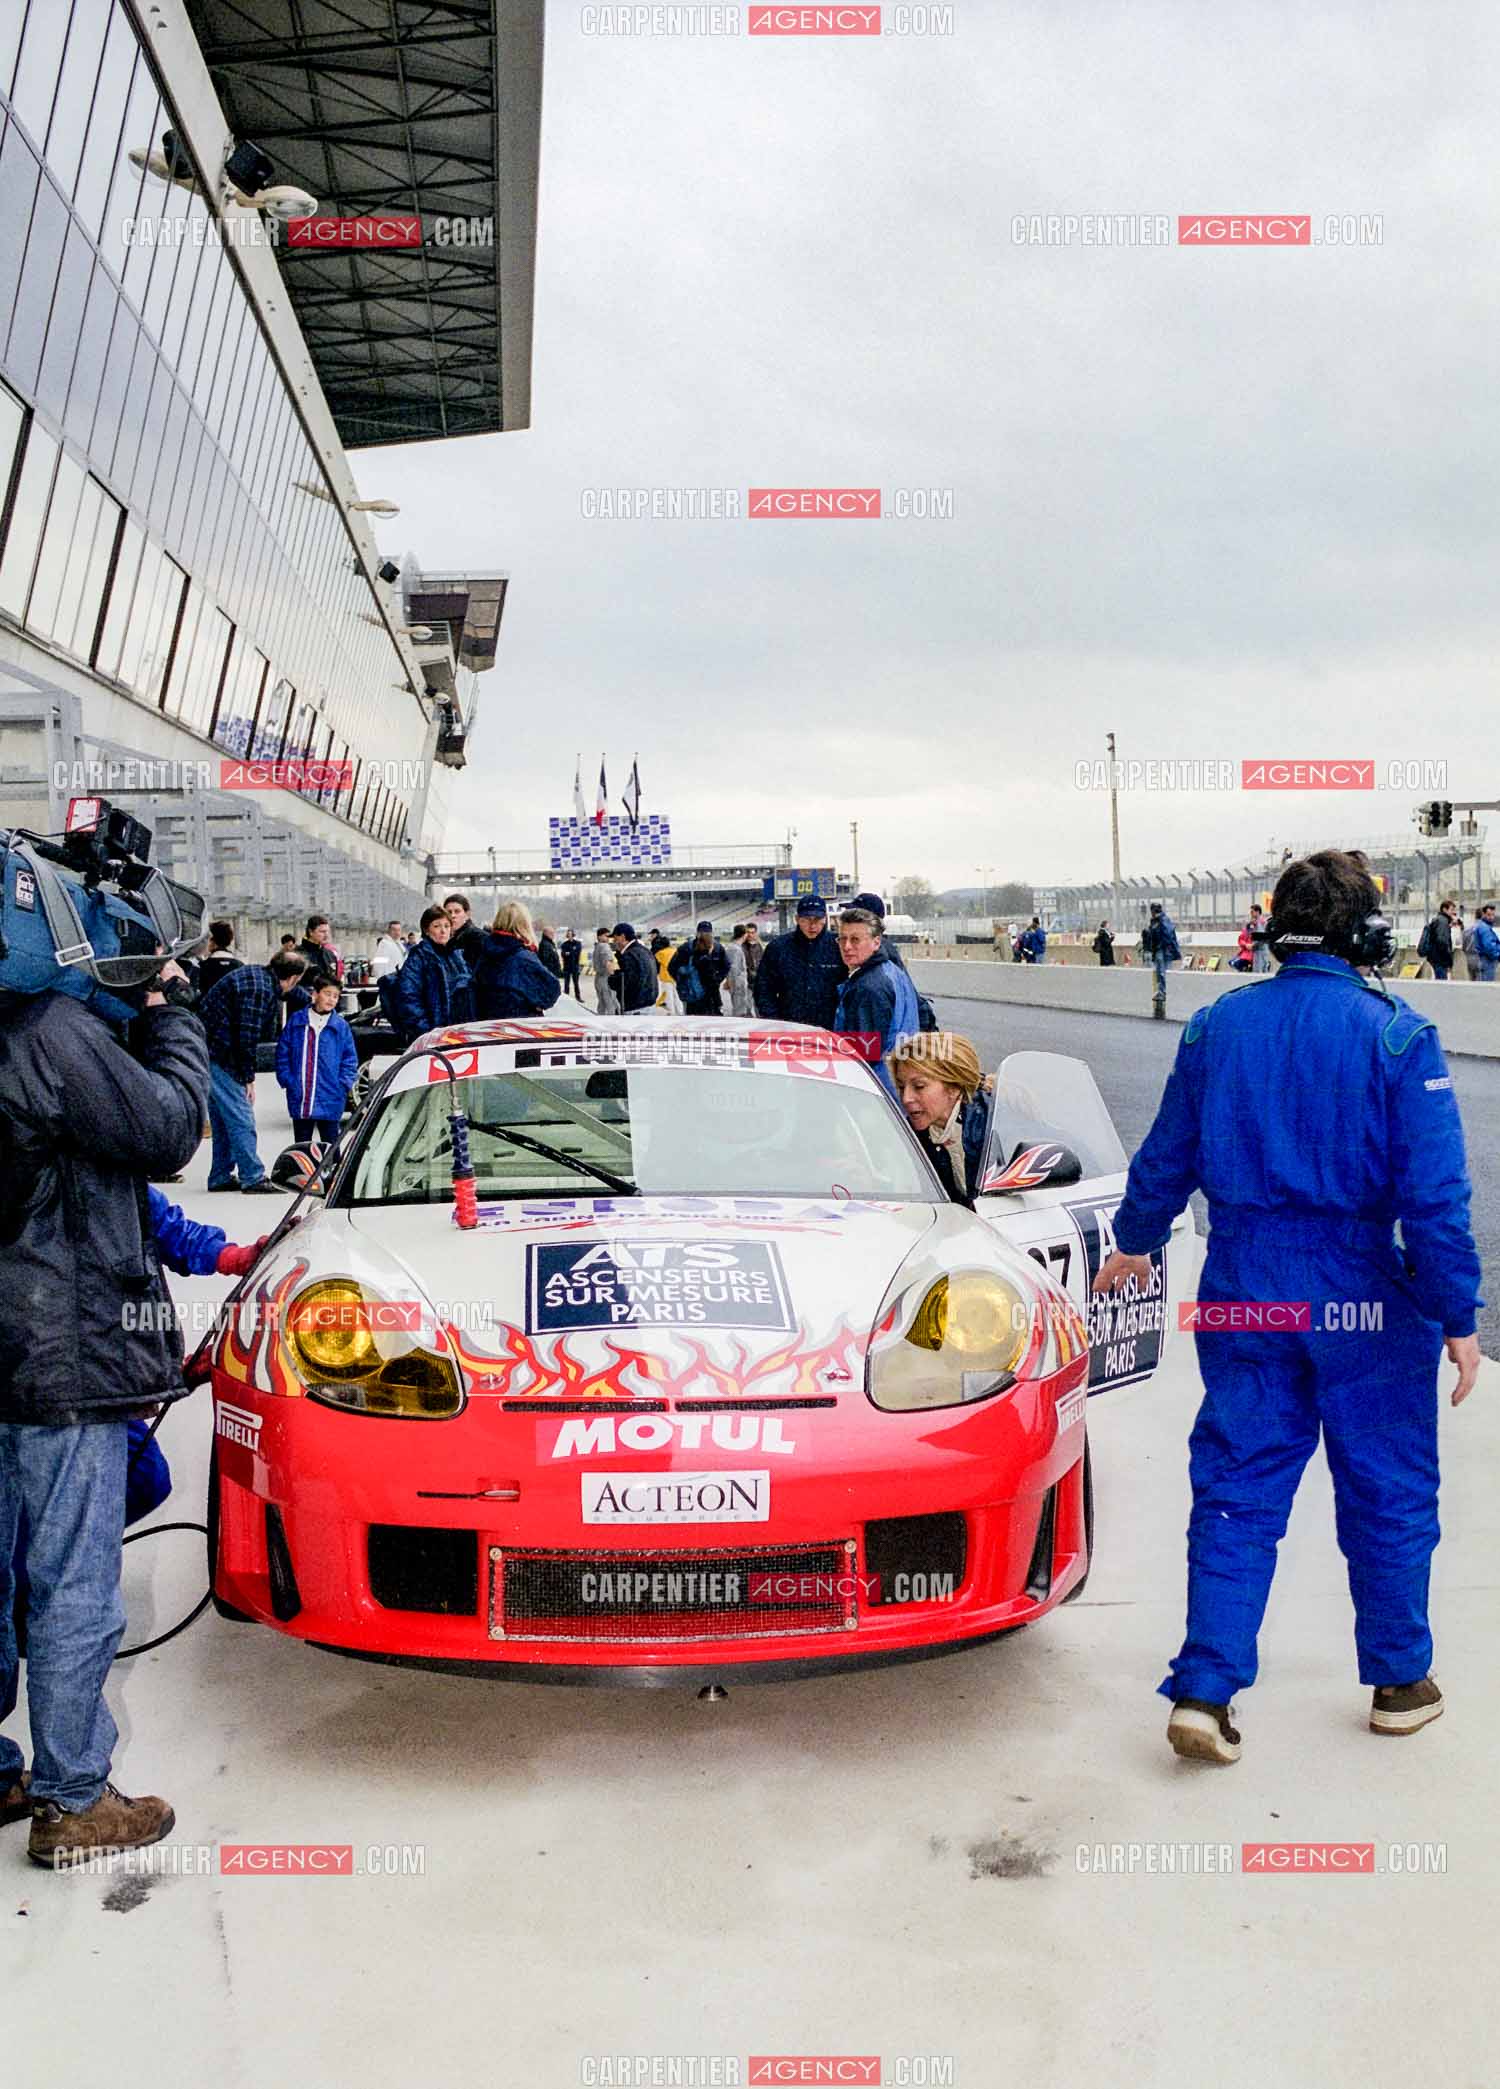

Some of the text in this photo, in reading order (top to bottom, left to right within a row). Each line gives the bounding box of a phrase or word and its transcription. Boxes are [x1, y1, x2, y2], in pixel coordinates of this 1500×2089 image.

[570, 1243, 739, 1270] ATS
[545, 1269, 768, 1289] ASCENSEURS
[545, 1284, 773, 1308] SUR MESURE
[611, 1303, 706, 1322] PARIS
[1105, 1340, 1137, 1377] PARIS
[216, 1400, 263, 1451] PIRELLI
[551, 1414, 796, 1458] MOTUL
[592, 1478, 763, 1513] ACTEON
